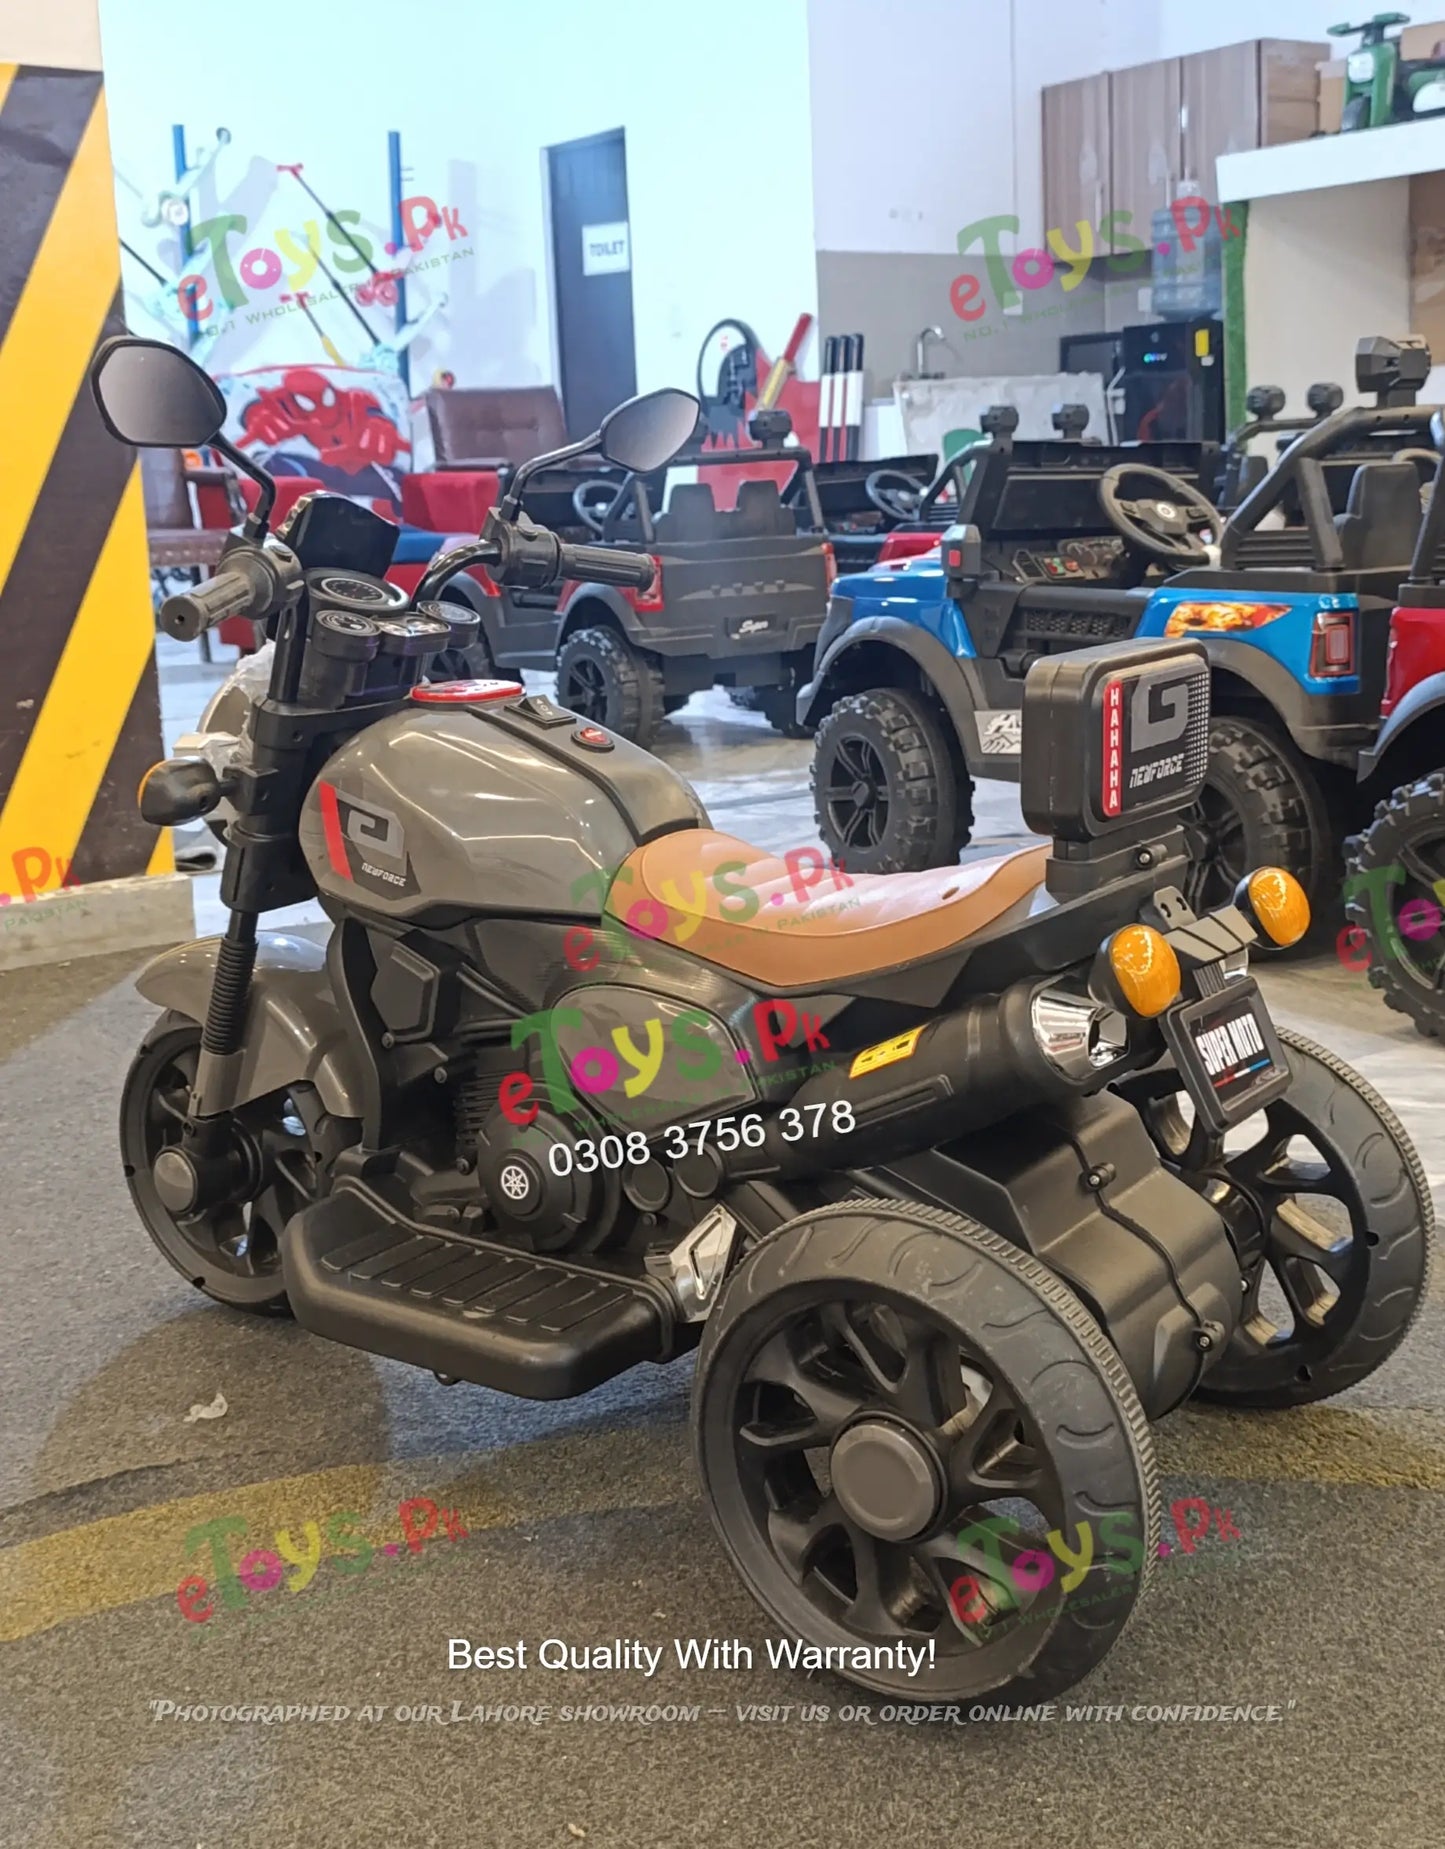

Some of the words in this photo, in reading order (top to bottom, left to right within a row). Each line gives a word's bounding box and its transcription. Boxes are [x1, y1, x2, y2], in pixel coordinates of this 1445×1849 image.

[1109, 688, 1119, 809] HAHAHA
[1195, 1025, 1239, 1075] SUPER
[1226, 1013, 1264, 1060] MOTO
